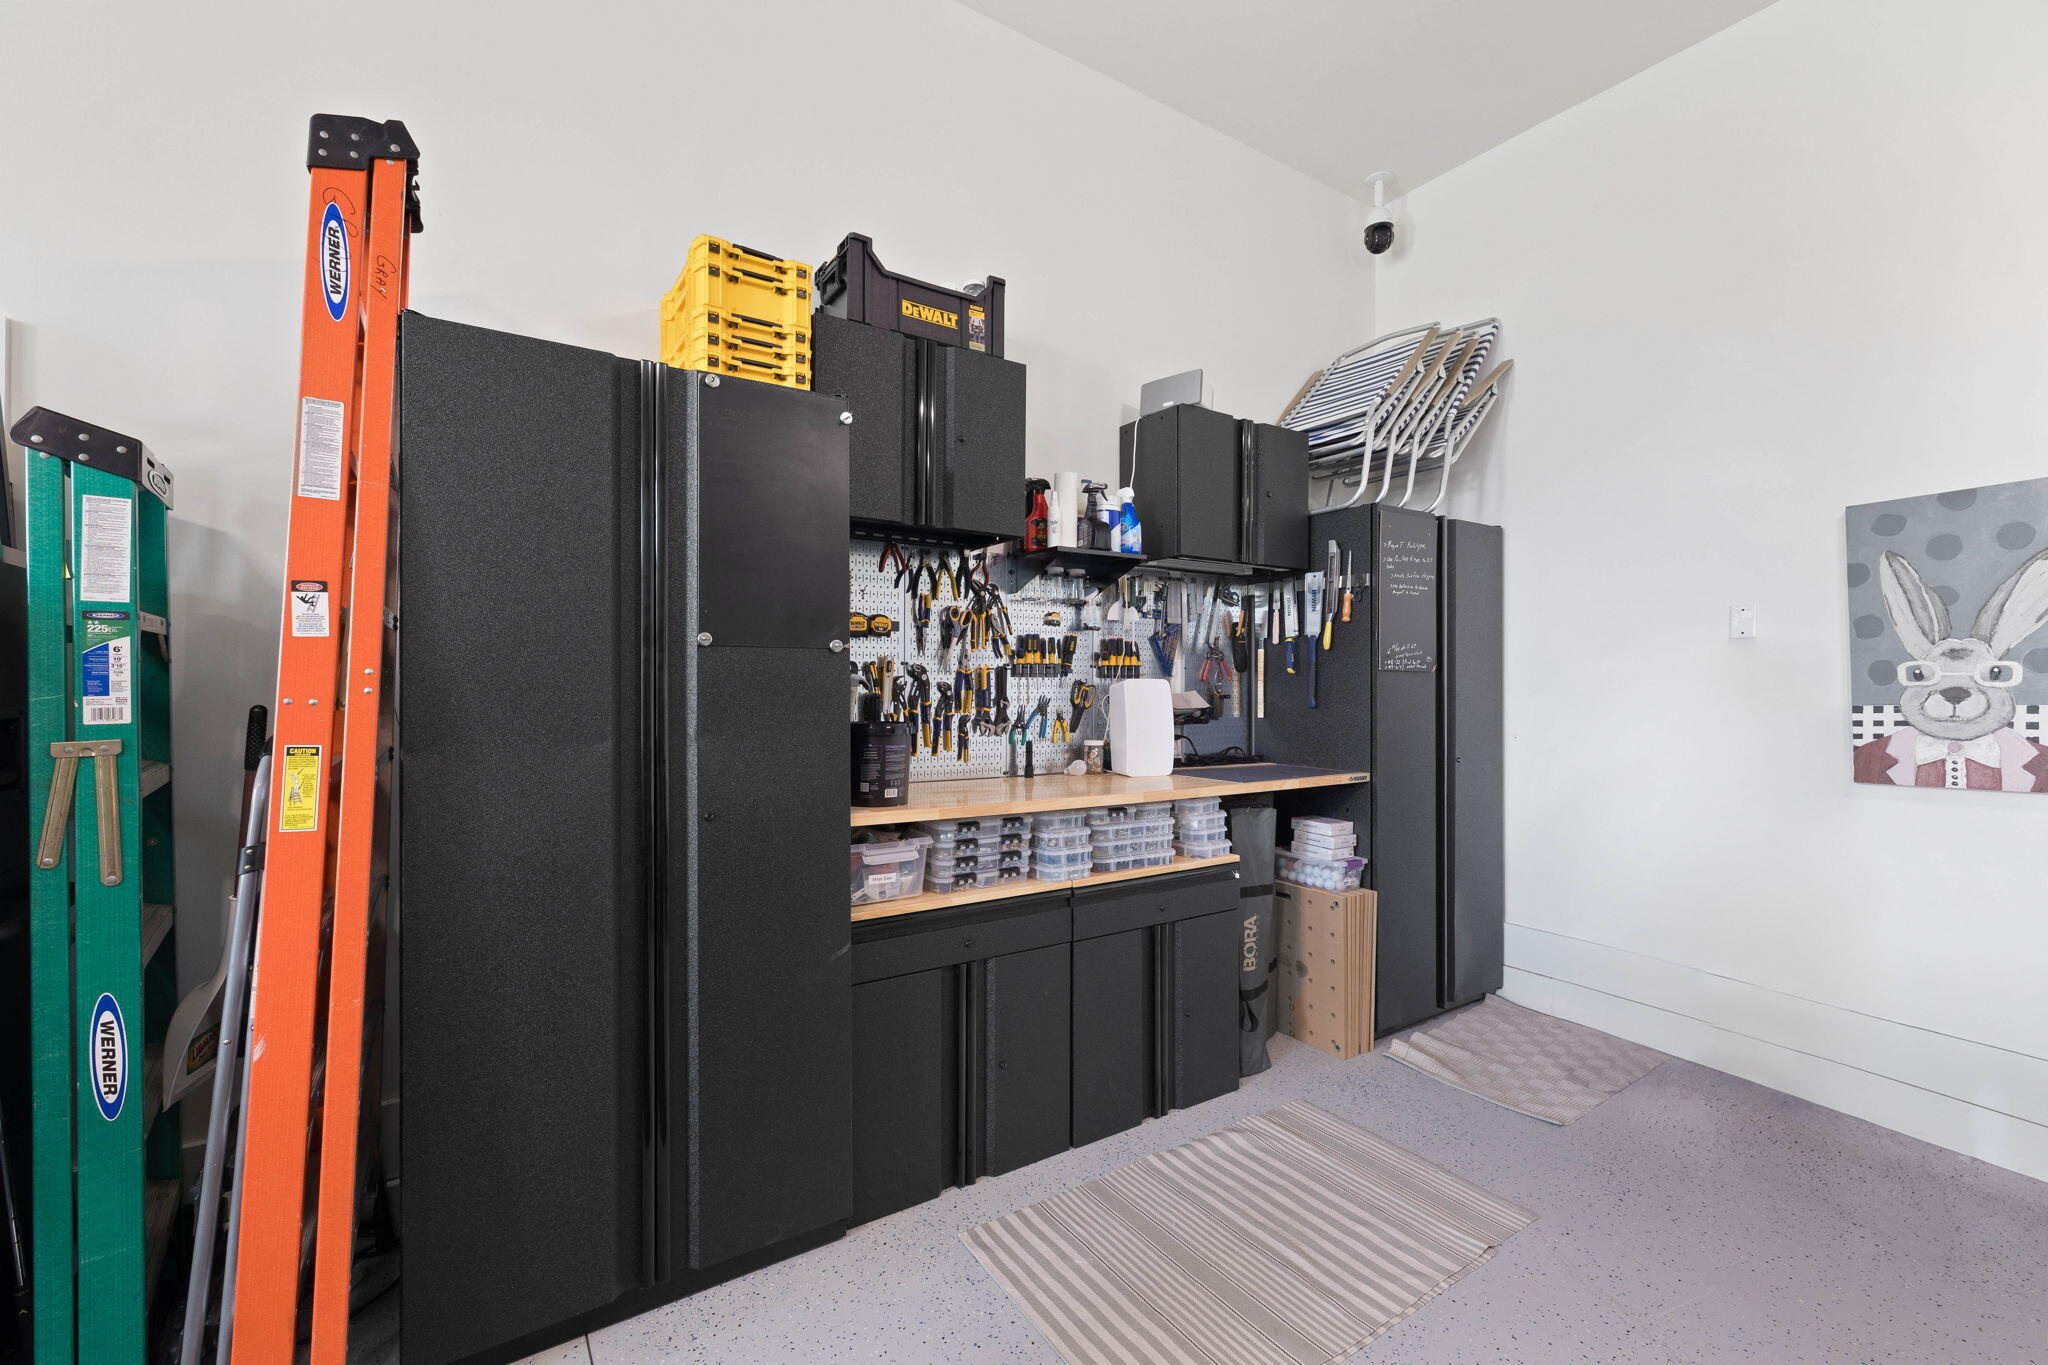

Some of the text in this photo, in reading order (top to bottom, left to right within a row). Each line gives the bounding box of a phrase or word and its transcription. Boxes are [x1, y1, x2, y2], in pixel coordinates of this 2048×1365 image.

[328, 226, 342, 296] WERNER
[902, 302, 958, 328] DEWALT
[87, 625, 108, 633] 225
[1243, 915, 1257, 972] BORA
[100, 1020, 118, 1096] WERNER
